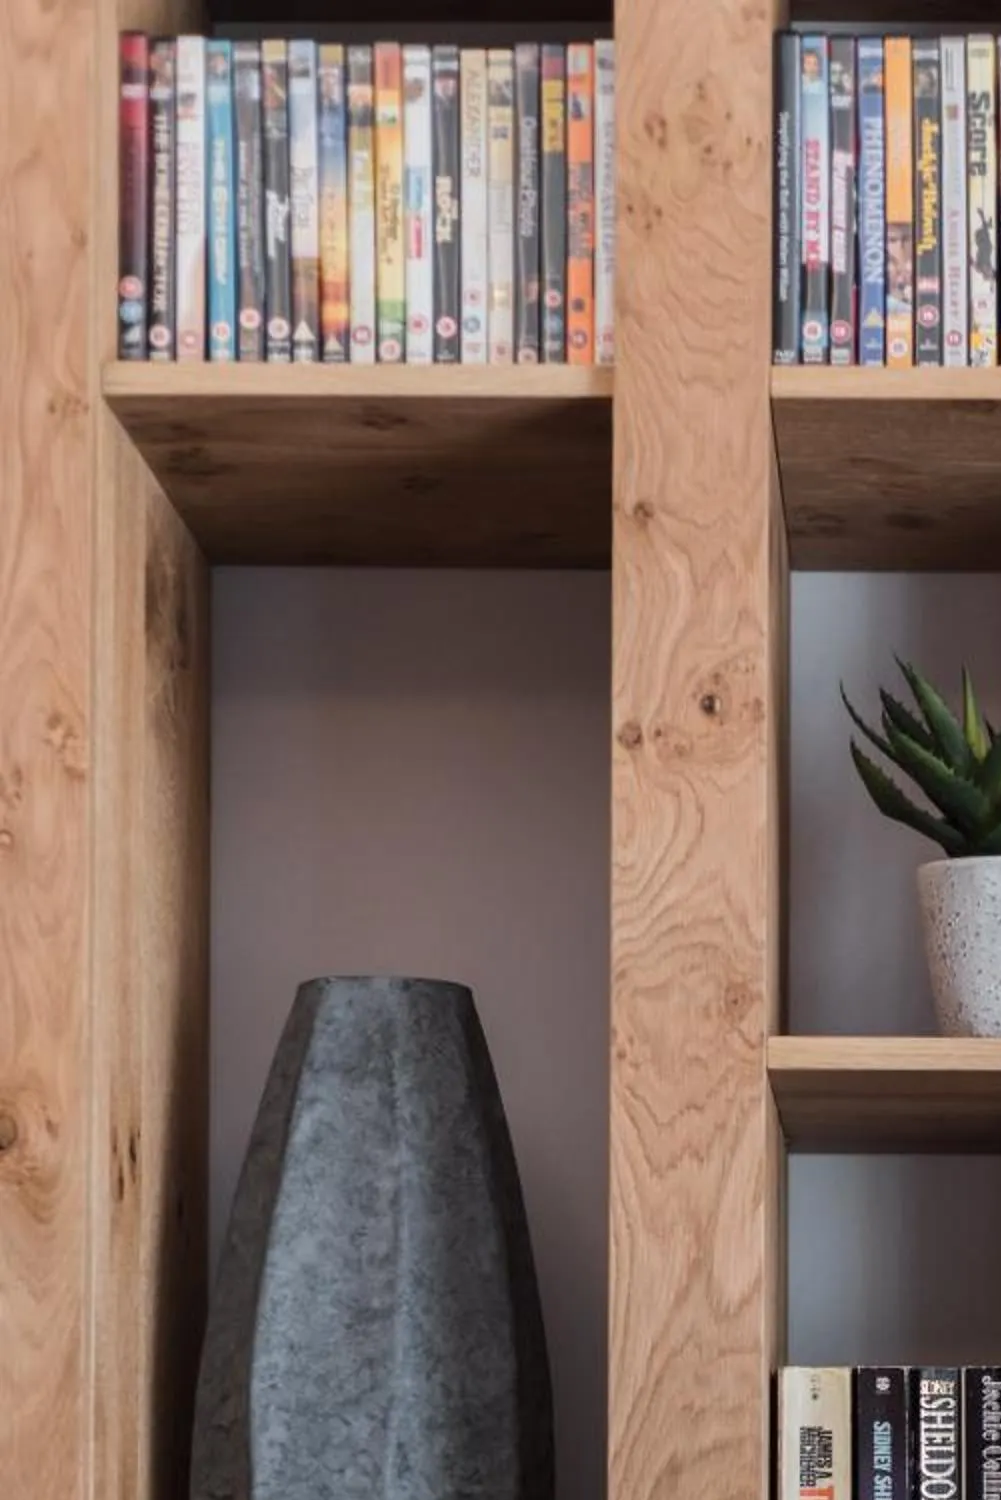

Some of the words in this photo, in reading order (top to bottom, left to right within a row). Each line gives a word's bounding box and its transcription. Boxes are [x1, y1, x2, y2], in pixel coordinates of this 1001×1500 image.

[969, 90, 991, 177] Score
[803, 139, 820, 203] STAND
[863, 116, 883, 284] PHENOMENON
[803, 210, 820, 233] BY
[800, 1426, 817, 1488] MICHENER
[817, 1428, 832, 1469] JAMES
[873, 1421, 893, 1471] SIDNEY
